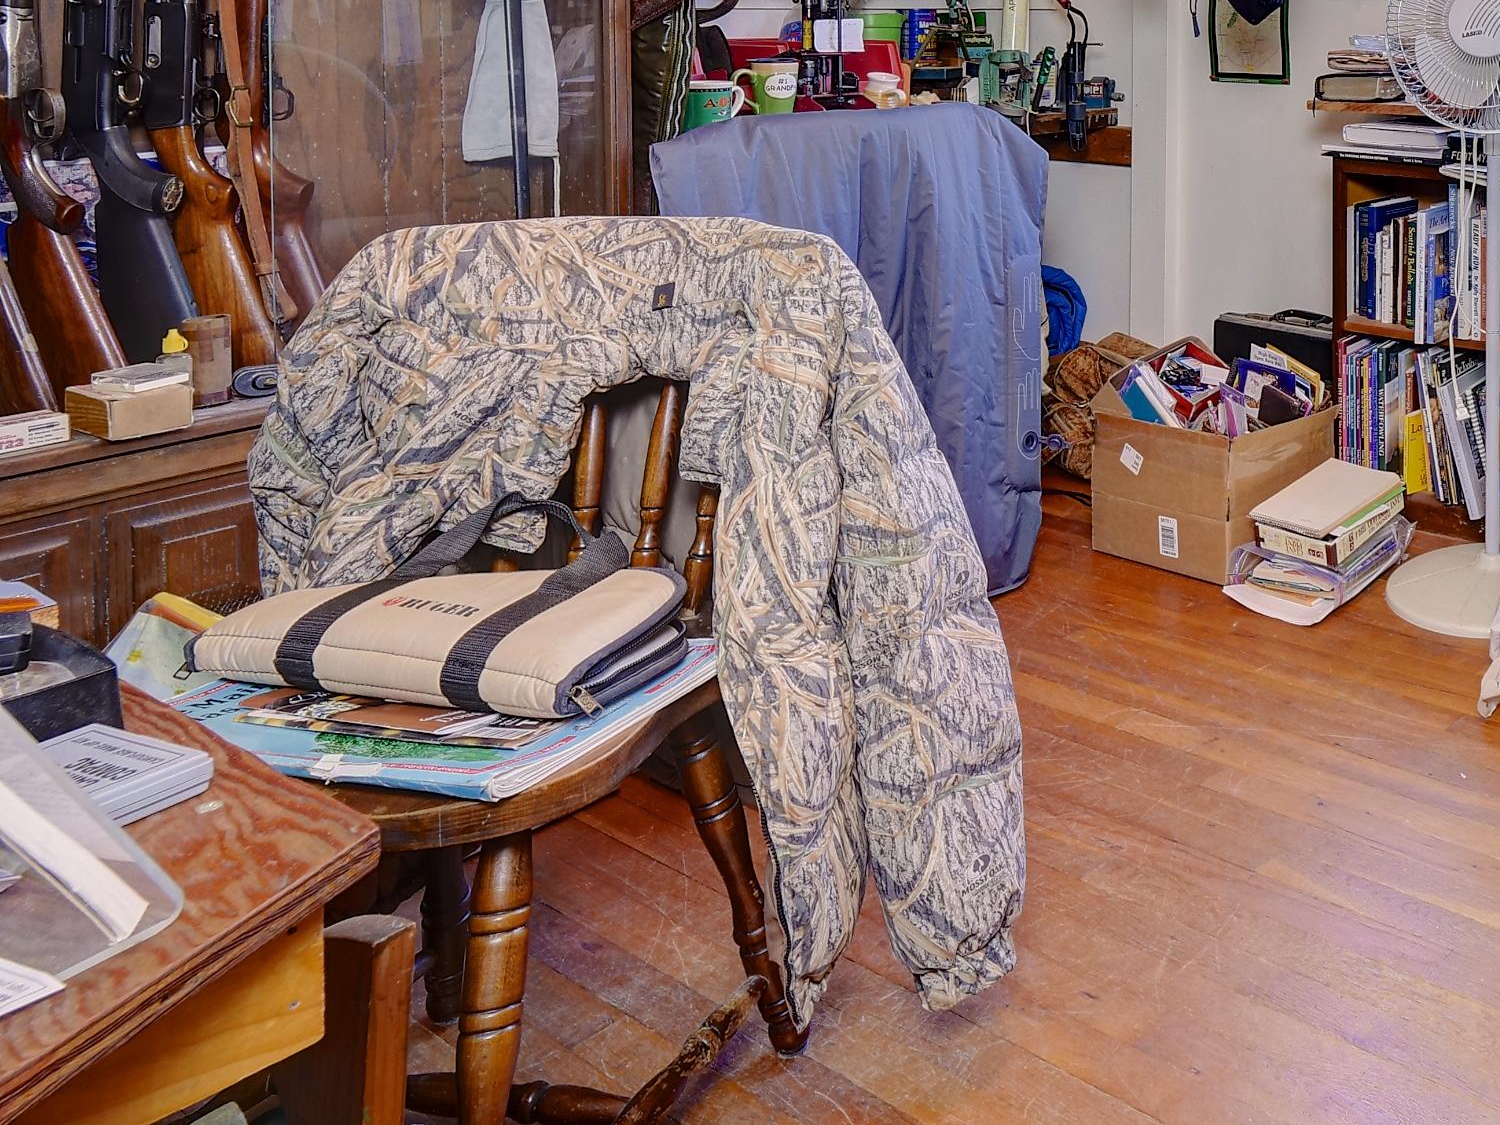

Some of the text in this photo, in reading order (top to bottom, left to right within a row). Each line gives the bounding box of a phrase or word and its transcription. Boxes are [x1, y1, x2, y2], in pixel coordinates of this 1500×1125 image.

[1461, 28, 1483, 39] LASKO
[1472, 223, 1480, 247] READY
[1406, 226, 1416, 285] Scottish Ballads
[400, 598, 480, 619] RUGER
